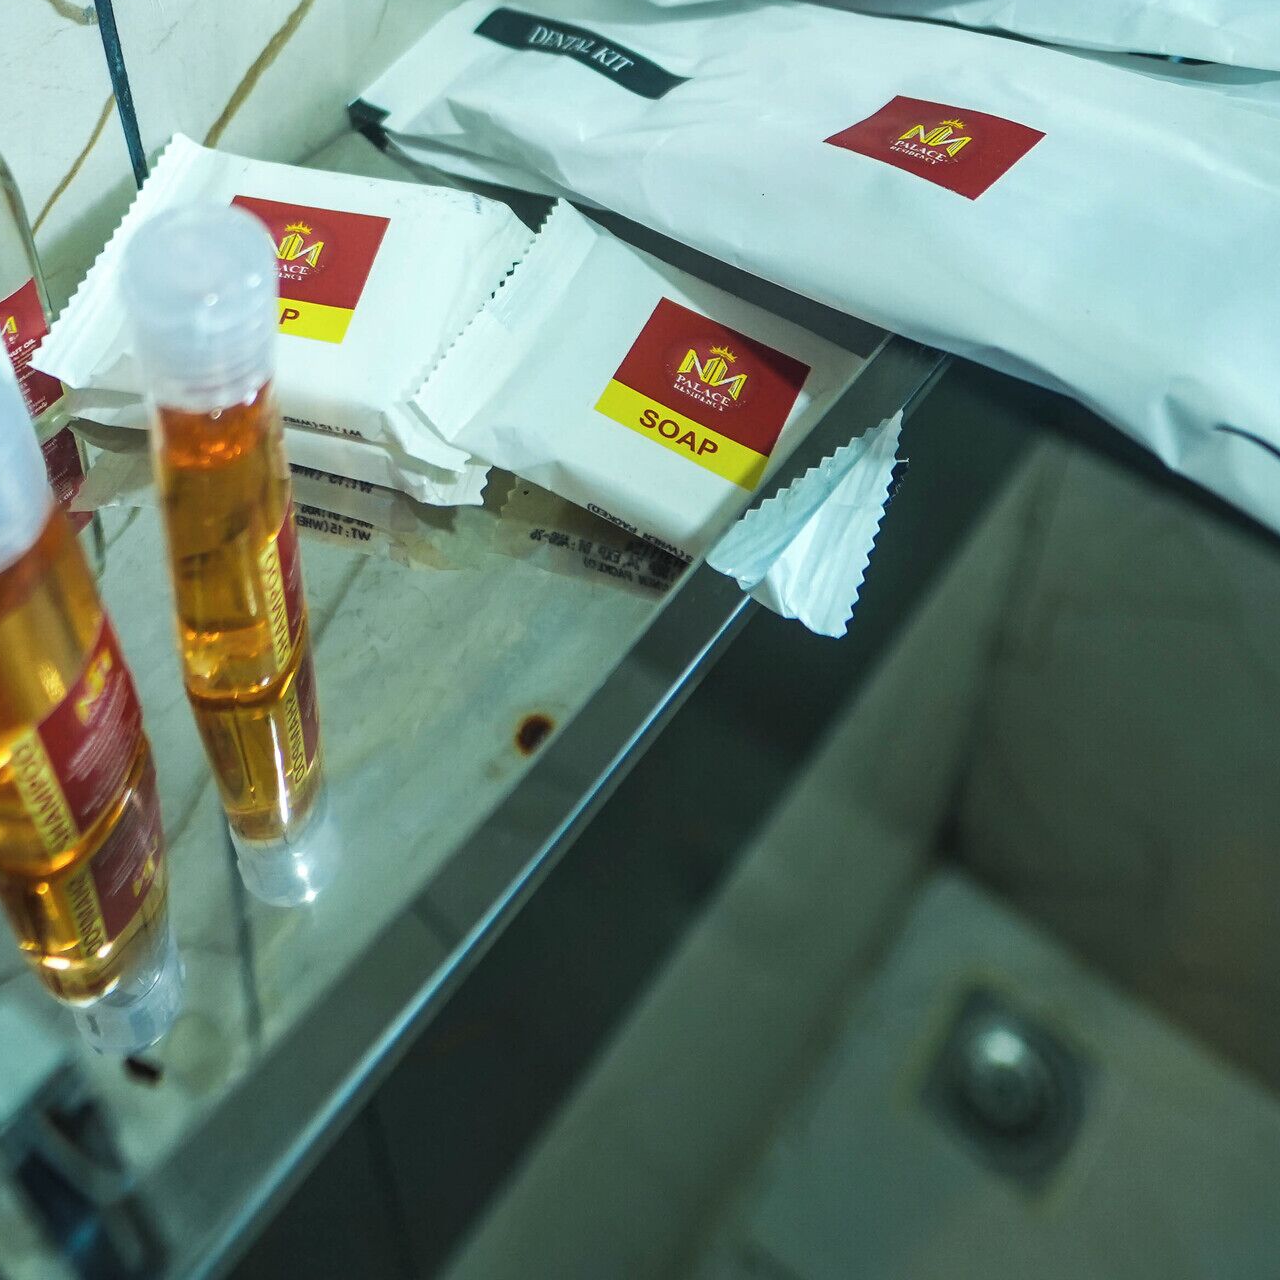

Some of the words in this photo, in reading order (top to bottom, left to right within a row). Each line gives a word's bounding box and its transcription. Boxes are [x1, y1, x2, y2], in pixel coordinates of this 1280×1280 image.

[528, 25, 596, 54] DENTAL
[591, 46, 635, 72] KIT
[894, 140, 948, 162] PALACE
[675, 373, 732, 407] PALACE
[639, 408, 719, 456] SOAP
[266, 551, 292, 666] SHAMPOO
[12, 742, 71, 853] SHAMPOO
